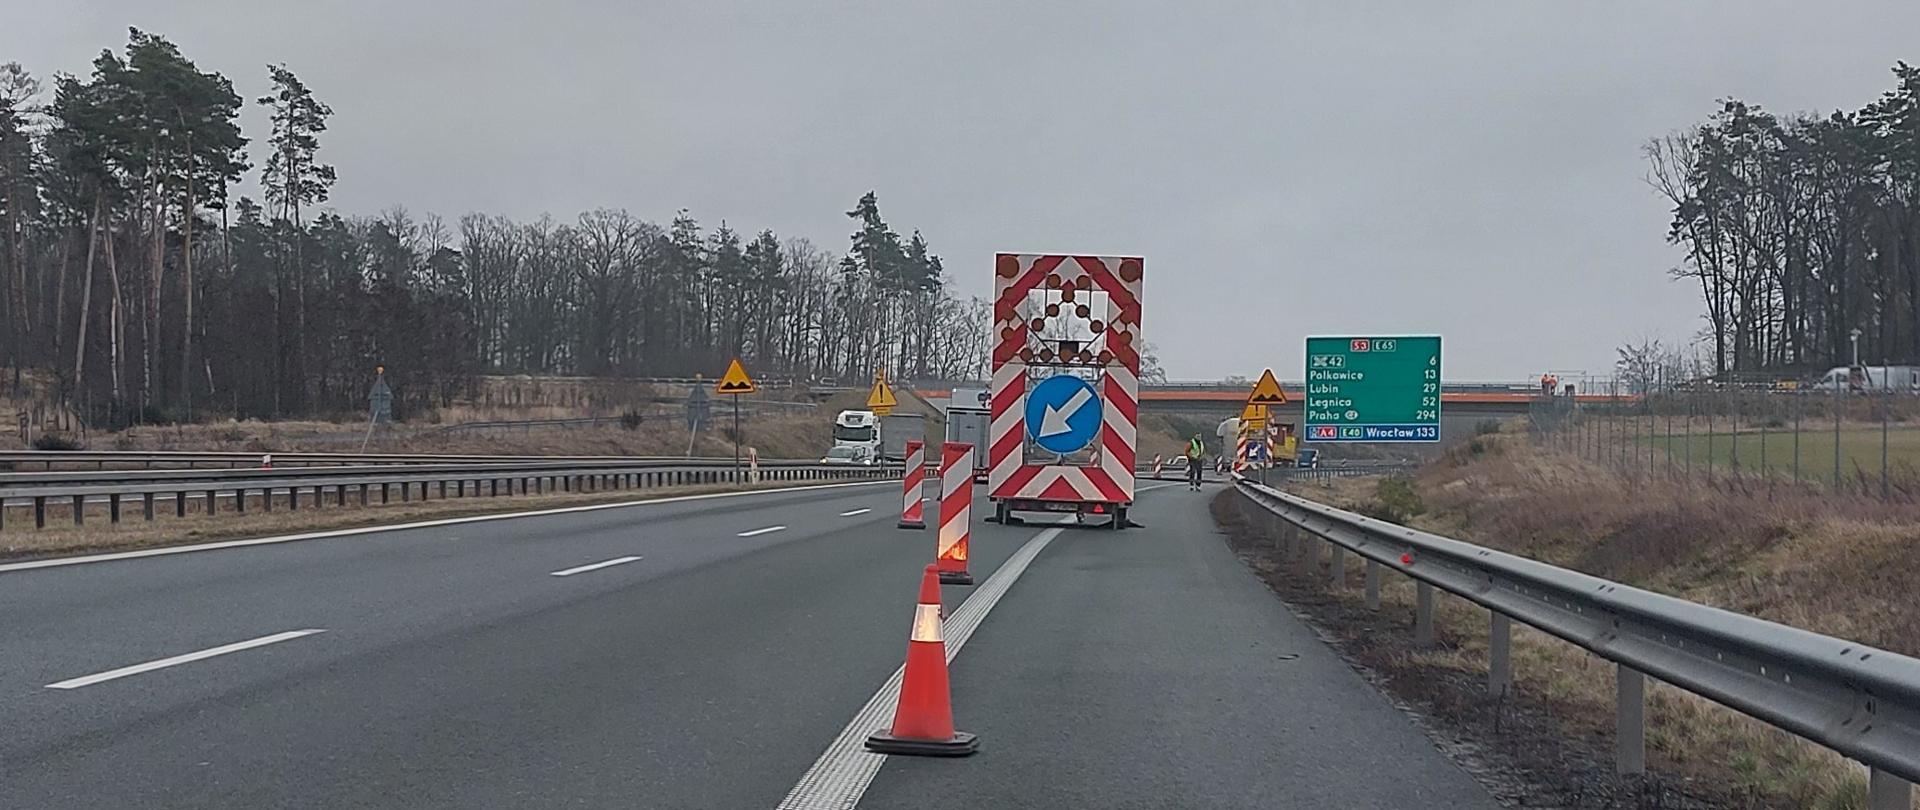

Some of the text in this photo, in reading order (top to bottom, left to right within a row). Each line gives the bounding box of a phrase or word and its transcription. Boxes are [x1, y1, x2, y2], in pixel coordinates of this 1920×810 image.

[1329, 356, 1436, 367] 42 6
[1309, 369, 1436, 380] Polkowice 13
[1309, 383, 1436, 394] Lubin 29
[1309, 397, 1436, 409] Legnica 52
[1309, 410, 1340, 420] Praha
[1416, 410, 1436, 420] 294
[1366, 427, 1414, 437] Wrocław
[1416, 427, 1436, 437] 133
